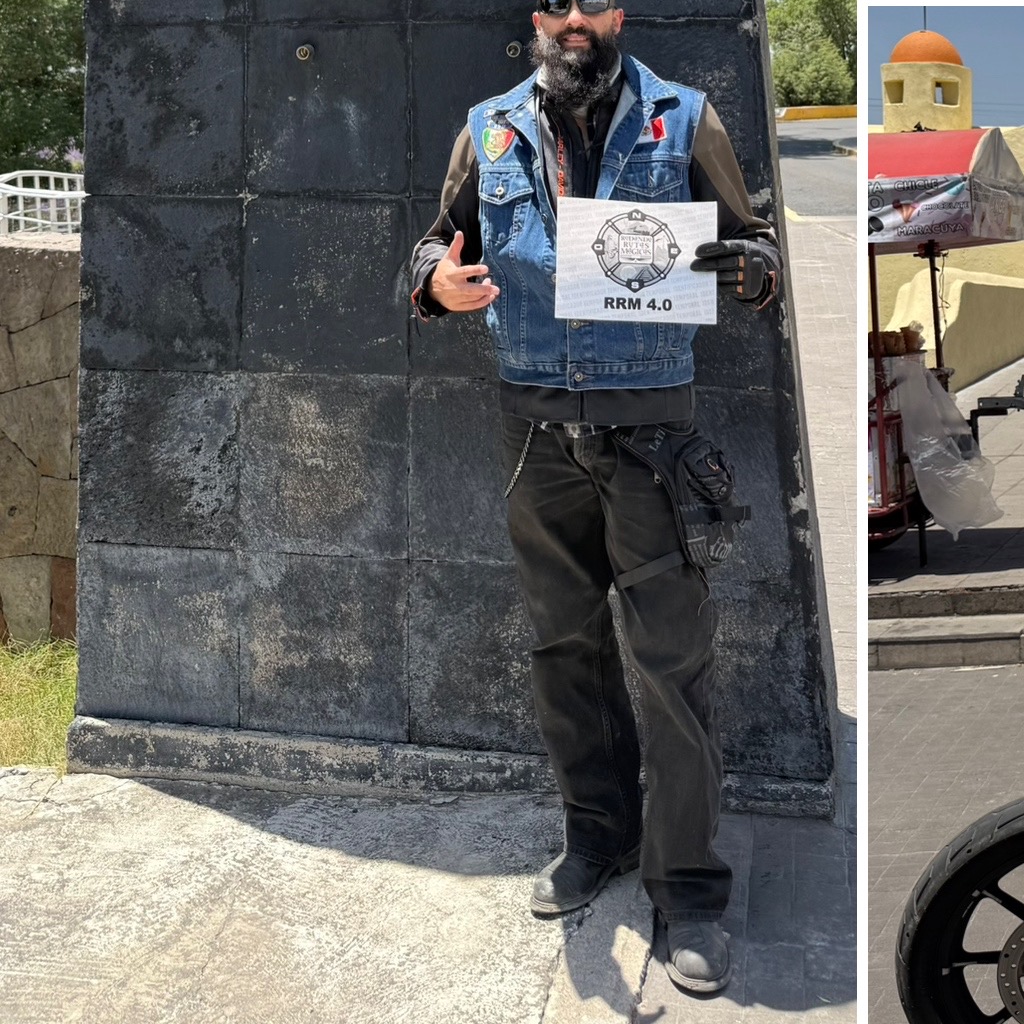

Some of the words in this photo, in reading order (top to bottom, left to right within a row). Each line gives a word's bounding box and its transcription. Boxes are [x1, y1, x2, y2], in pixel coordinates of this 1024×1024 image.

[894, 179, 939, 192] CHICLE
[920, 200, 970, 212] CHOCOLATE
[604, 296, 641, 311] RRM
[646, 298, 672, 311] 4.0
